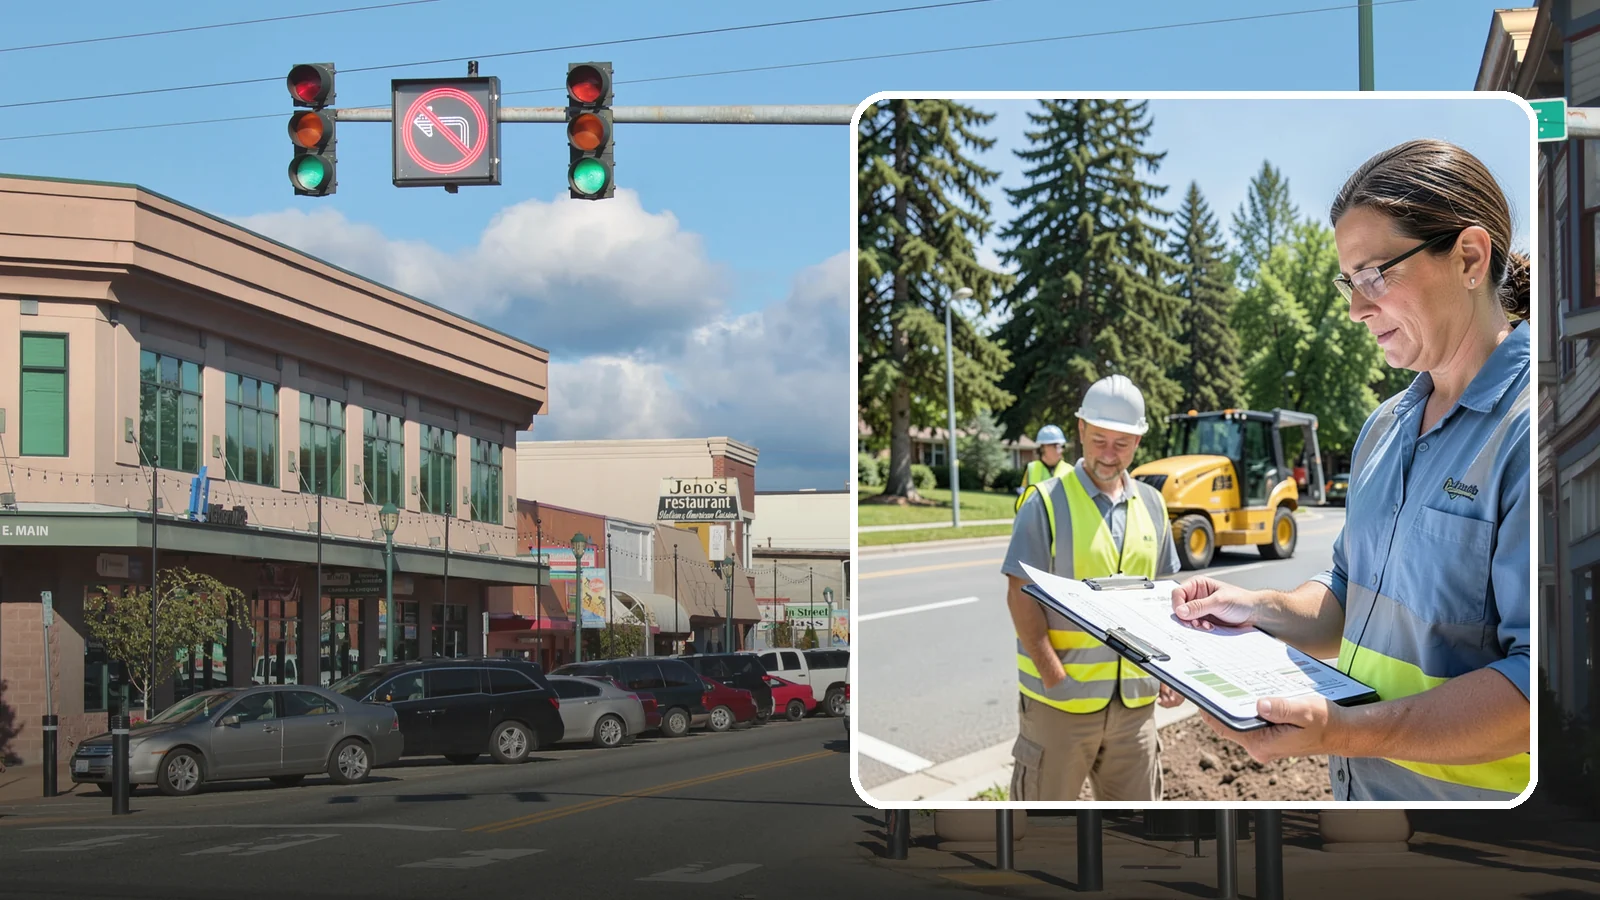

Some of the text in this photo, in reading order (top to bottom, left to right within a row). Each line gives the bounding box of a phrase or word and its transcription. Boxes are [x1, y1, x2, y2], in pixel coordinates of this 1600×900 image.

[670, 480, 727, 495] Jeno's
[665, 496, 731, 509] restaurant
[686, 509, 714, 519] American
[715, 509, 737, 519] Cuisine
[2, 525, 49, 536] E. MAIN
[797, 607, 829, 617] Street
[791, 619, 823, 627] lass
